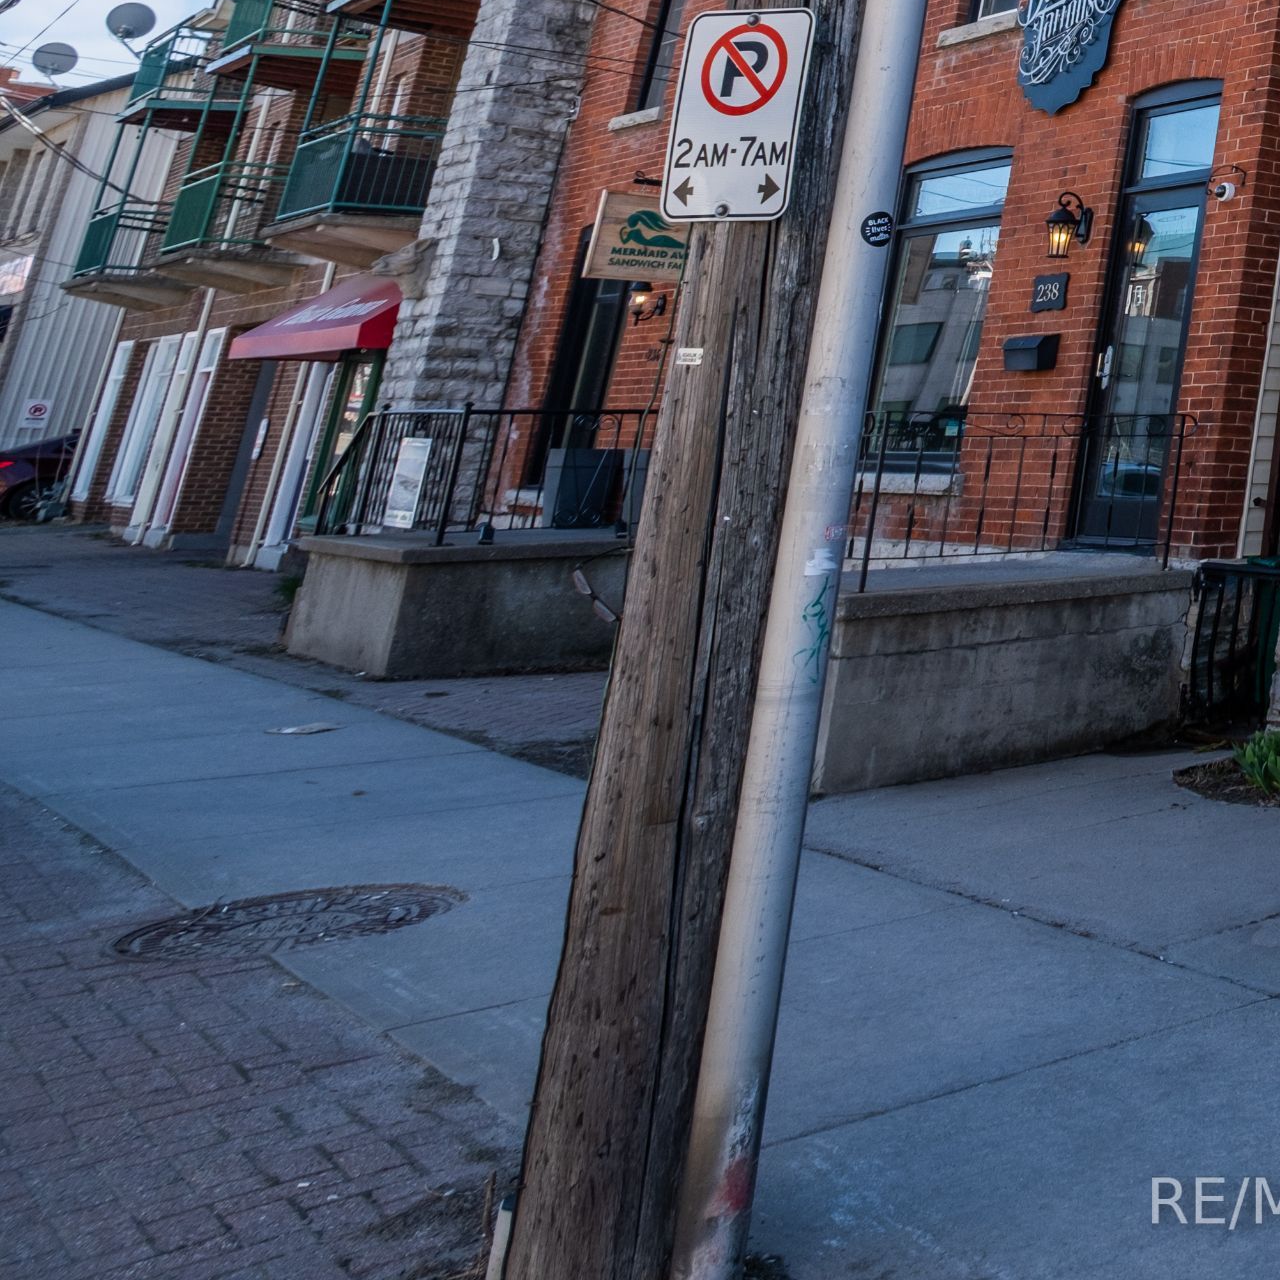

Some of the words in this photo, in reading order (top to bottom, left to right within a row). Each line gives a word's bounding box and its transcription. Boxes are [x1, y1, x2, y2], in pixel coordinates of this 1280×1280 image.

[868, 217, 889, 226] BLACK
[610, 246, 668, 259] MERMAID
[607, 257, 665, 269] SANDWICH
[1035, 282, 1060, 303] 238
